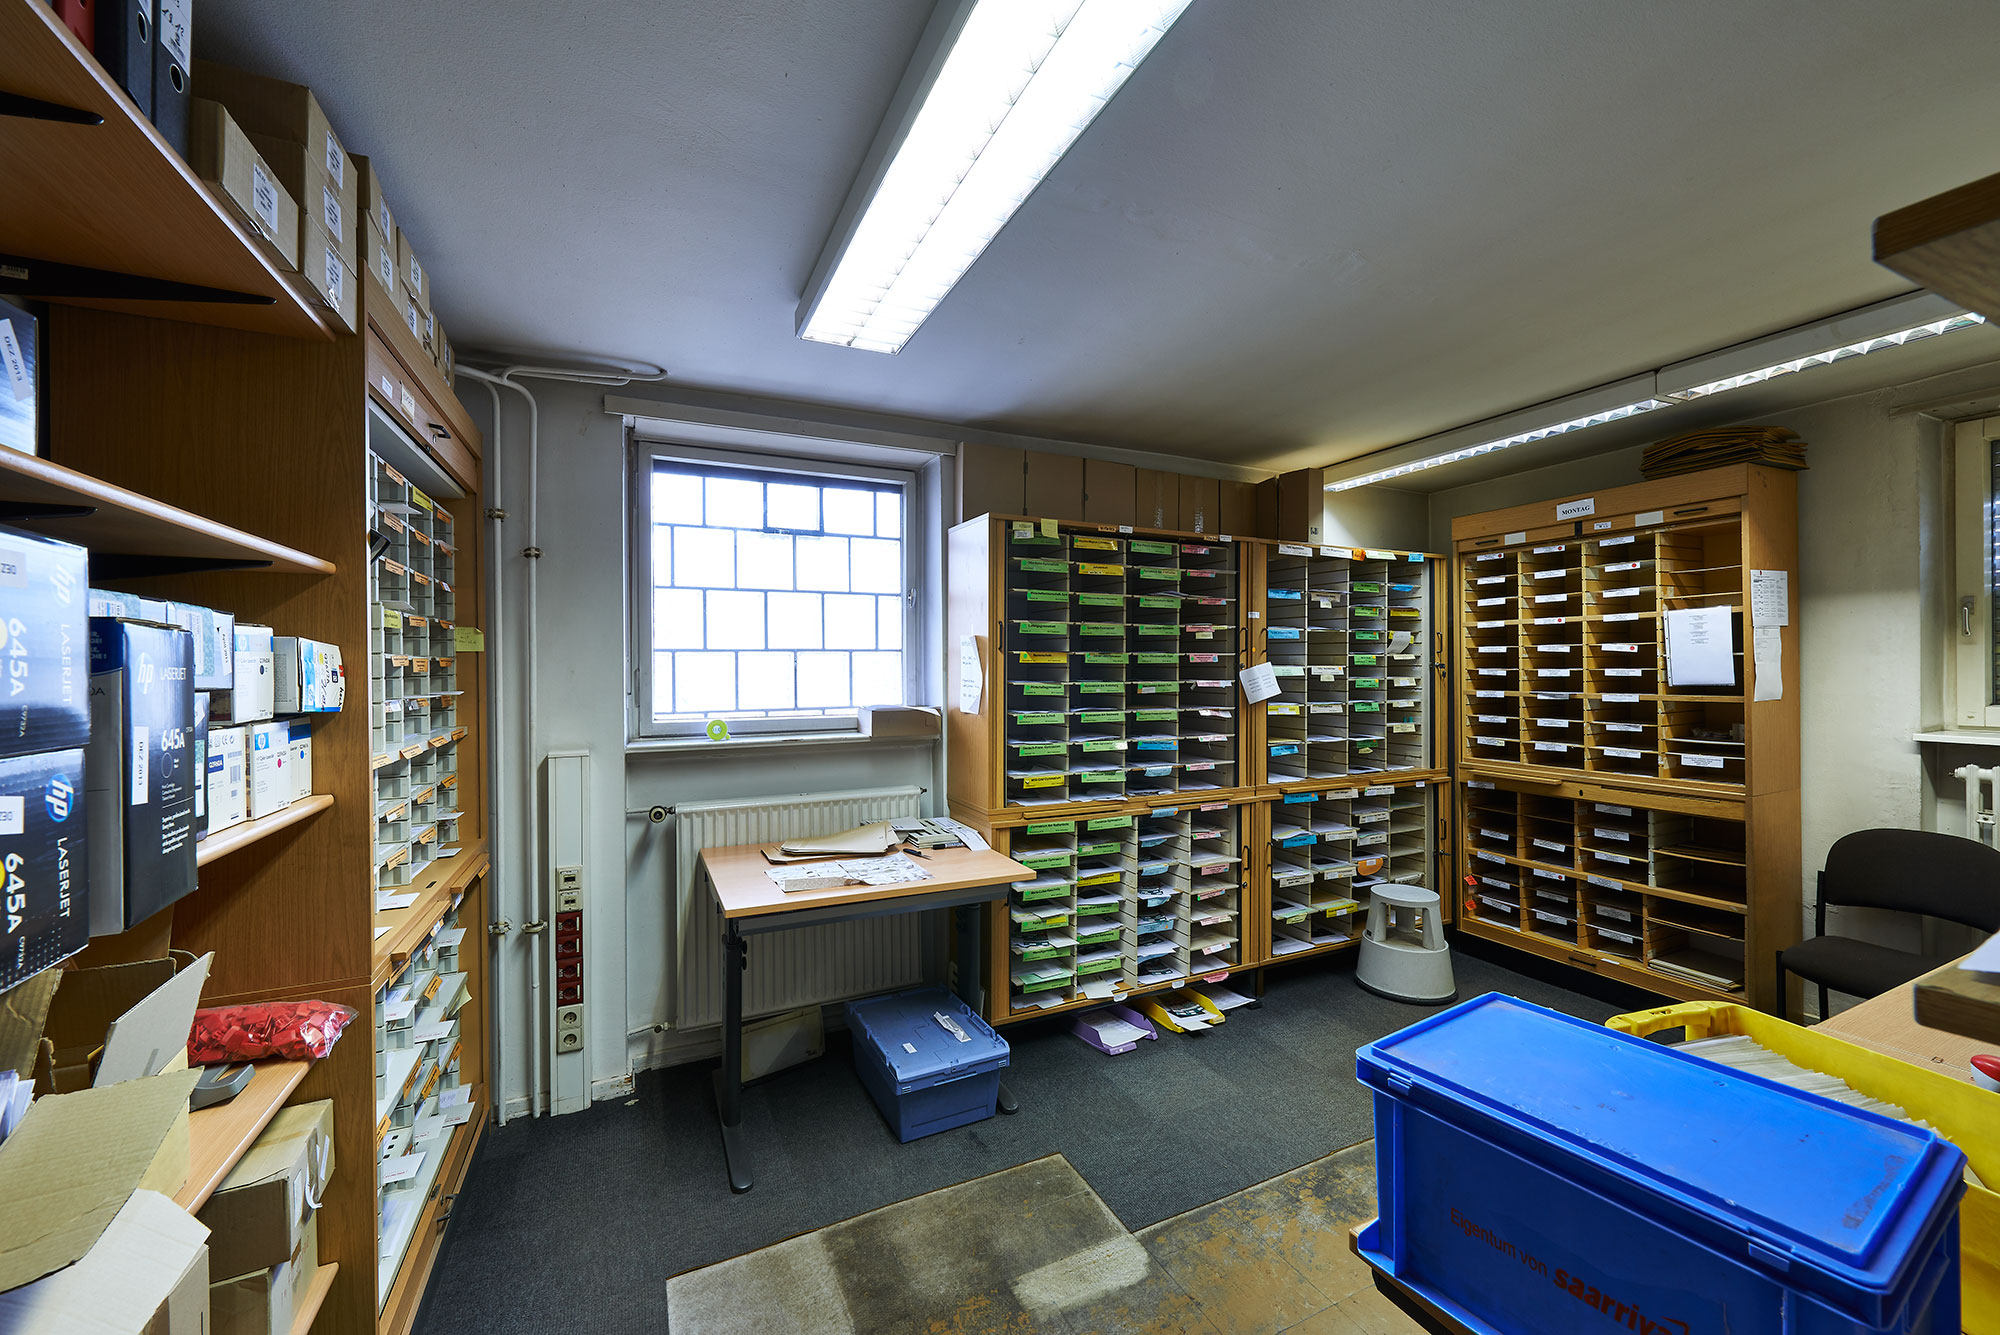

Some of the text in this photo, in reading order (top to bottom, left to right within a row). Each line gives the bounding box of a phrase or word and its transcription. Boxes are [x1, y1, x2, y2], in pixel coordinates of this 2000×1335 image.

[1562, 505, 1591, 515] MONTAG
[50, 563, 77, 605] hp
[9, 617, 28, 697] 645A
[60, 623, 73, 705] LASERJET
[137, 652, 154, 695] hp
[160, 667, 187, 681] LASERJET
[161, 728, 185, 751] 645A
[45, 779, 75, 819] hp
[5, 853, 26, 934] 645A
[57, 836, 70, 918] LASERJET
[1450, 1207, 1517, 1260] Eigentum
[1519, 1249, 1548, 1277] von
